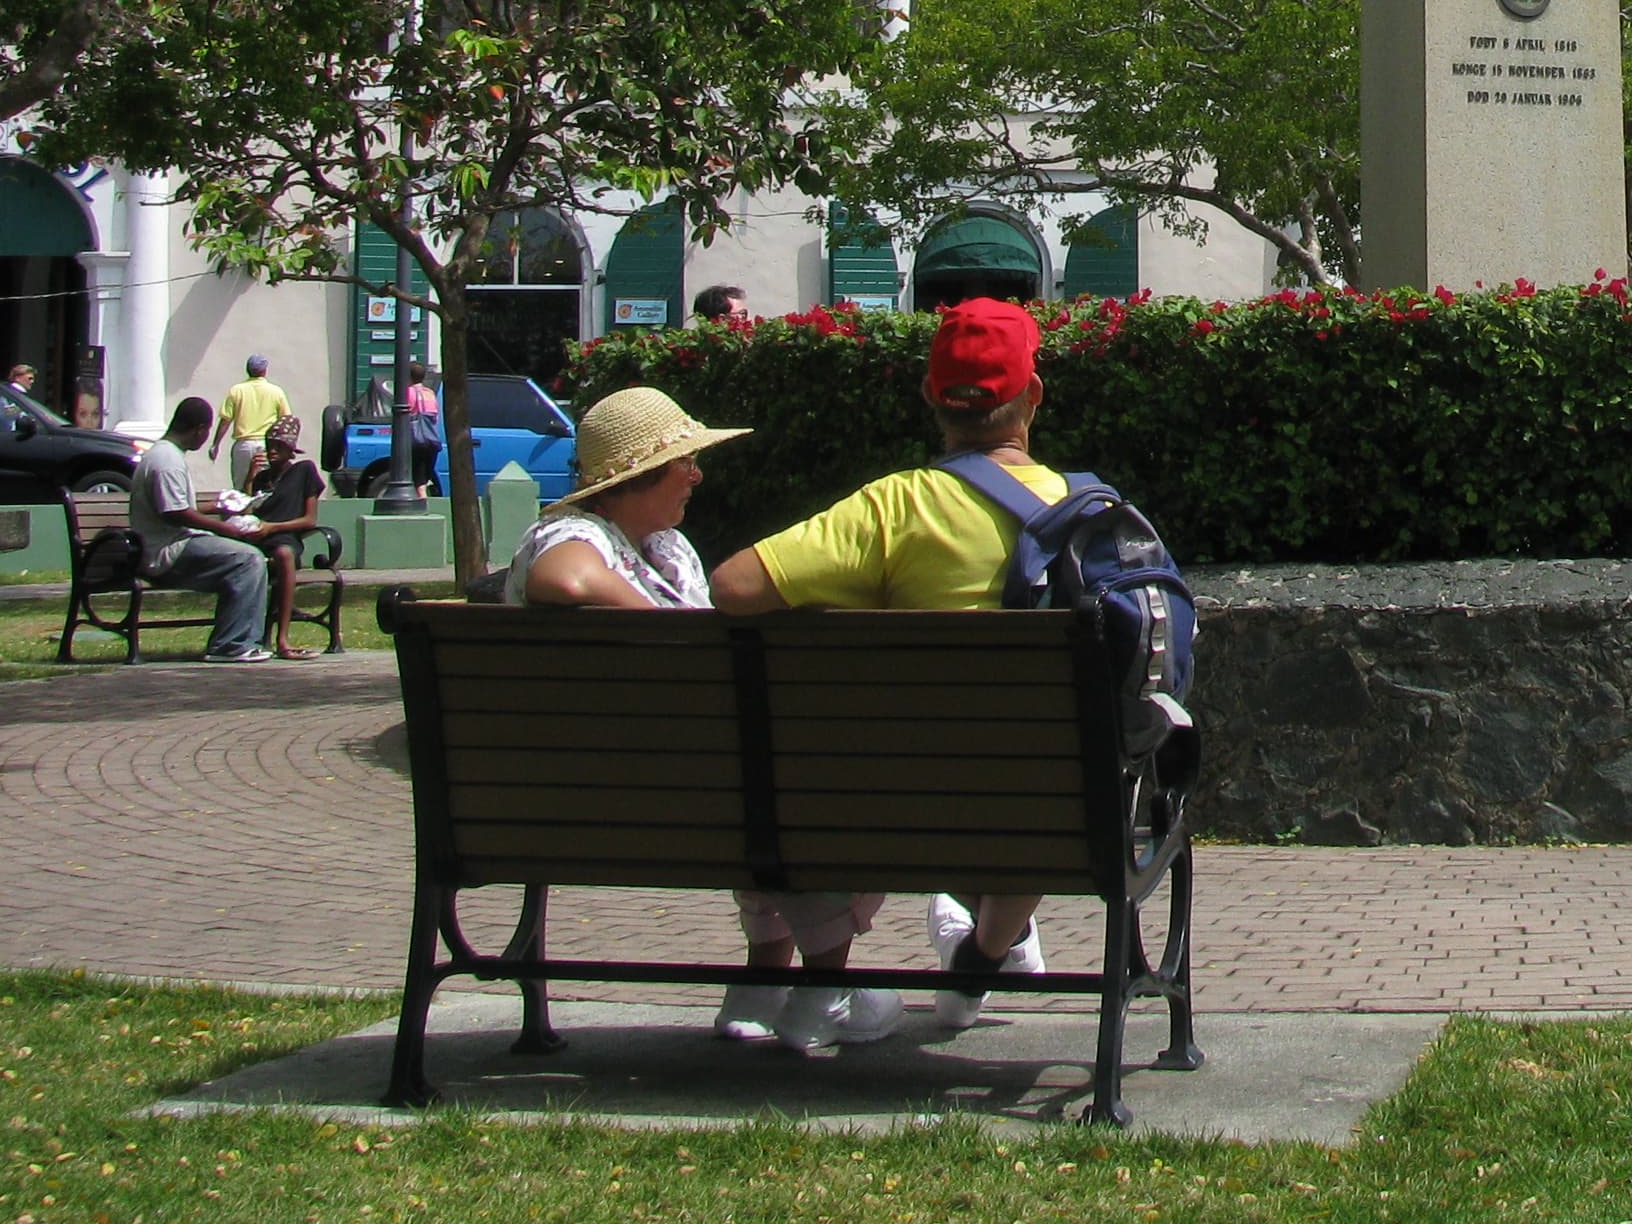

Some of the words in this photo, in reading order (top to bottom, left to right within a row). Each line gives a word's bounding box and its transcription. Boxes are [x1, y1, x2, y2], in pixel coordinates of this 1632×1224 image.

[1515, 38, 1545, 52] APRIL
[1452, 63, 1487, 76] KONGE
[1492, 64, 1502, 76] 15
[1508, 65, 1565, 78] NOVEMBER
[1511, 92, 1552, 106] JANUAR
[1558, 94, 1583, 107] 1906
